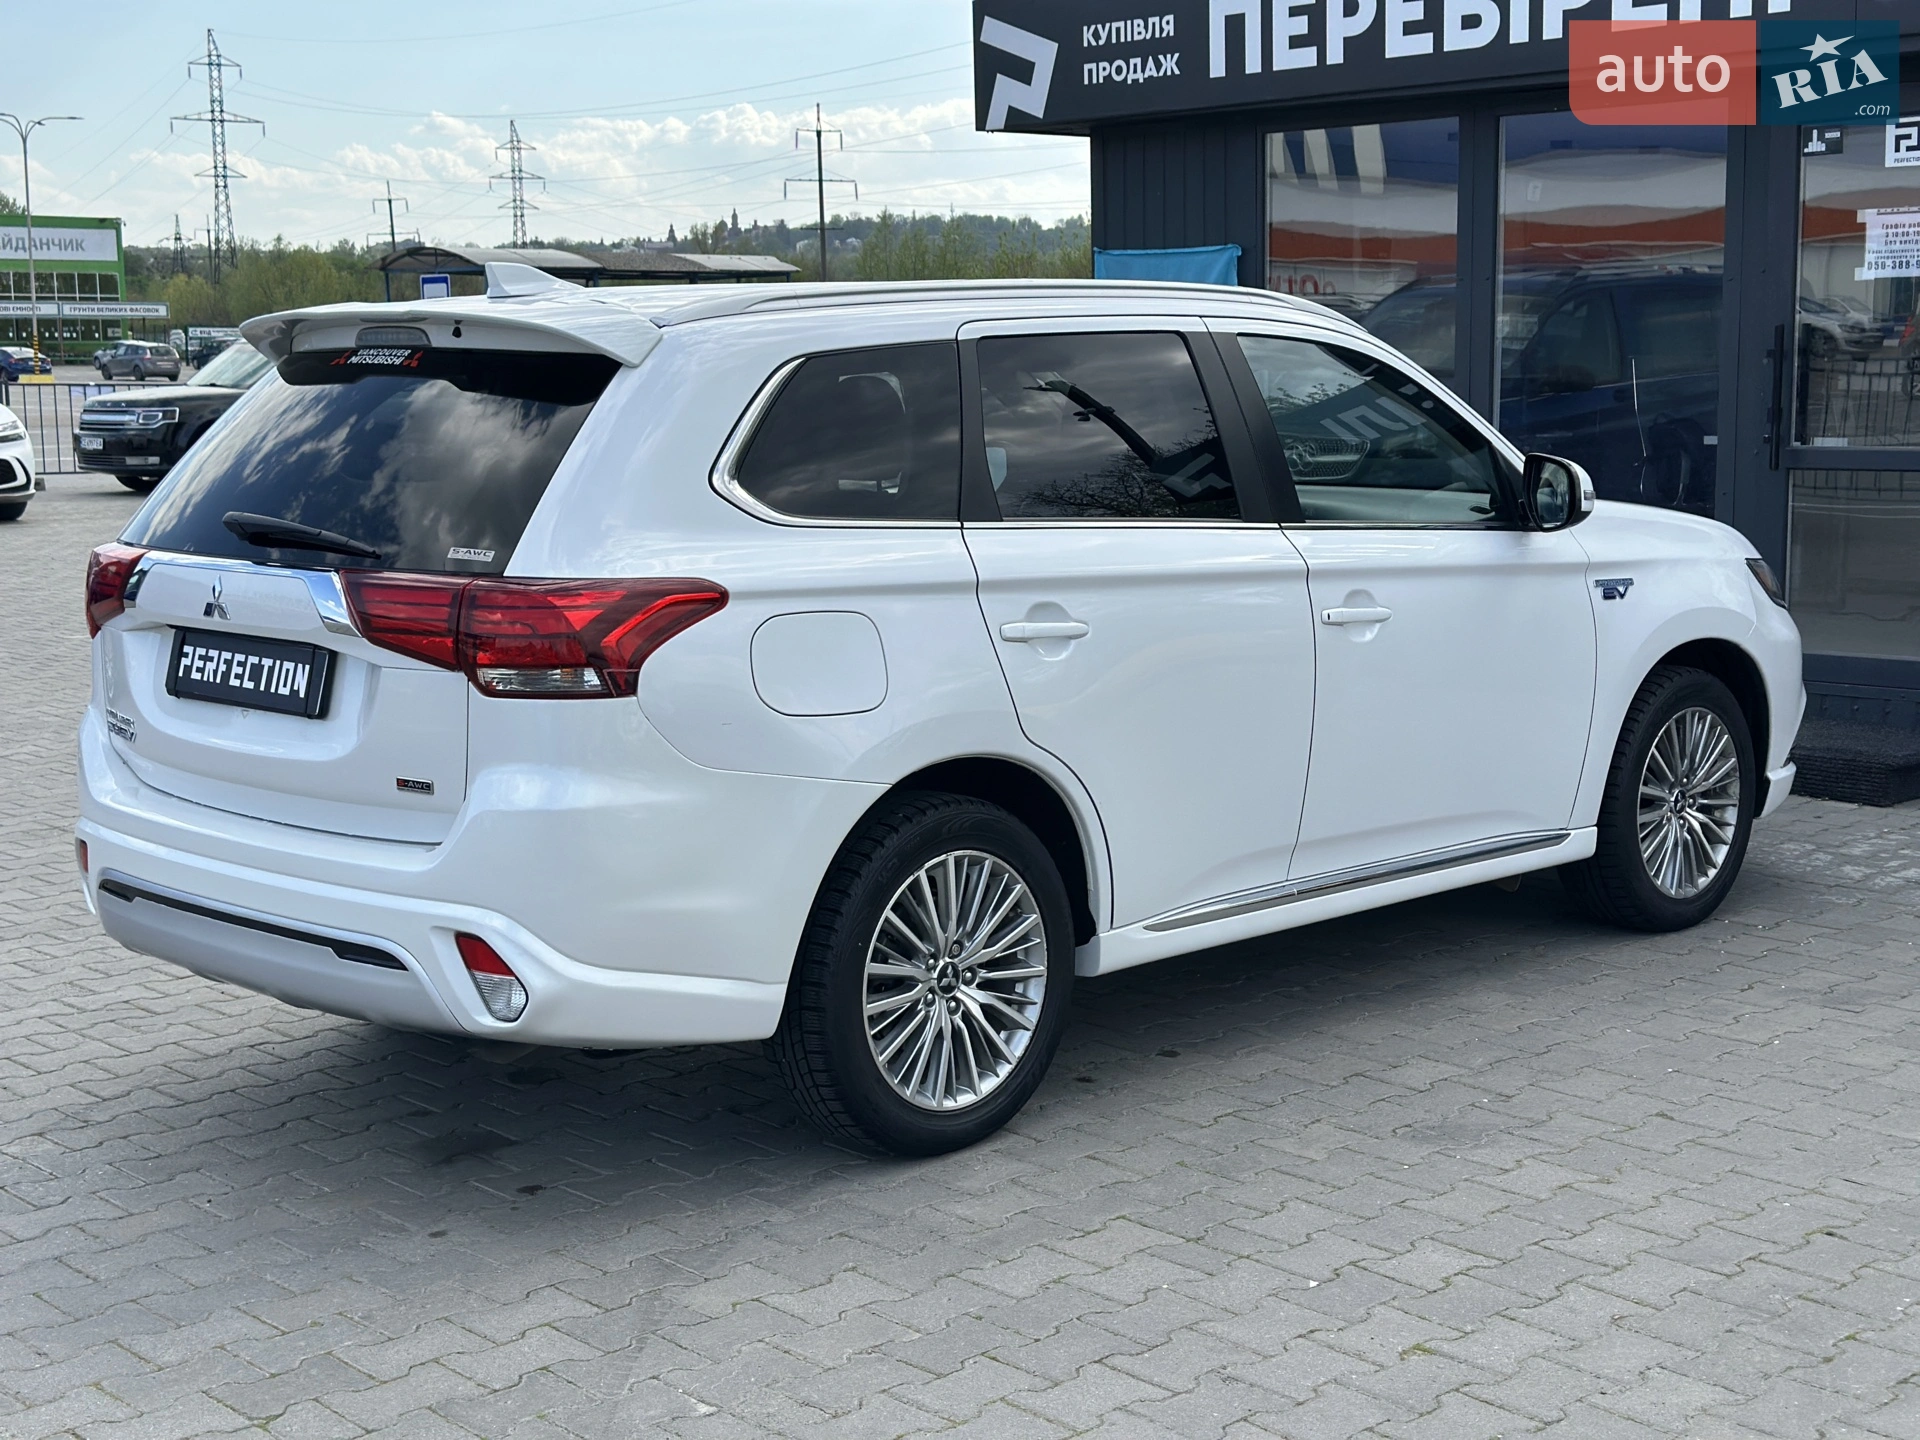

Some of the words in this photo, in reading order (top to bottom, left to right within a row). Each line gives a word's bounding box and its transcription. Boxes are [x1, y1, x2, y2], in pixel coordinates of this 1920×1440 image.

[1083, 14, 1175, 47] КУПІВЛЯ
[1209, 0, 1790, 78] ПЕРЕВІР
[1083, 53, 1180, 85] ПРОДАЖ
[0, 233, 85, 252] ЙДАНЧИК
[347, 355, 406, 365] MITSUBISHI
[357, 348, 412, 356] VANCOUVER
[452, 548, 493, 558] S-AWC
[1602, 586, 1630, 600] EV
[178, 645, 310, 698] PERFECTION
[398, 780, 430, 790] S-AWC
